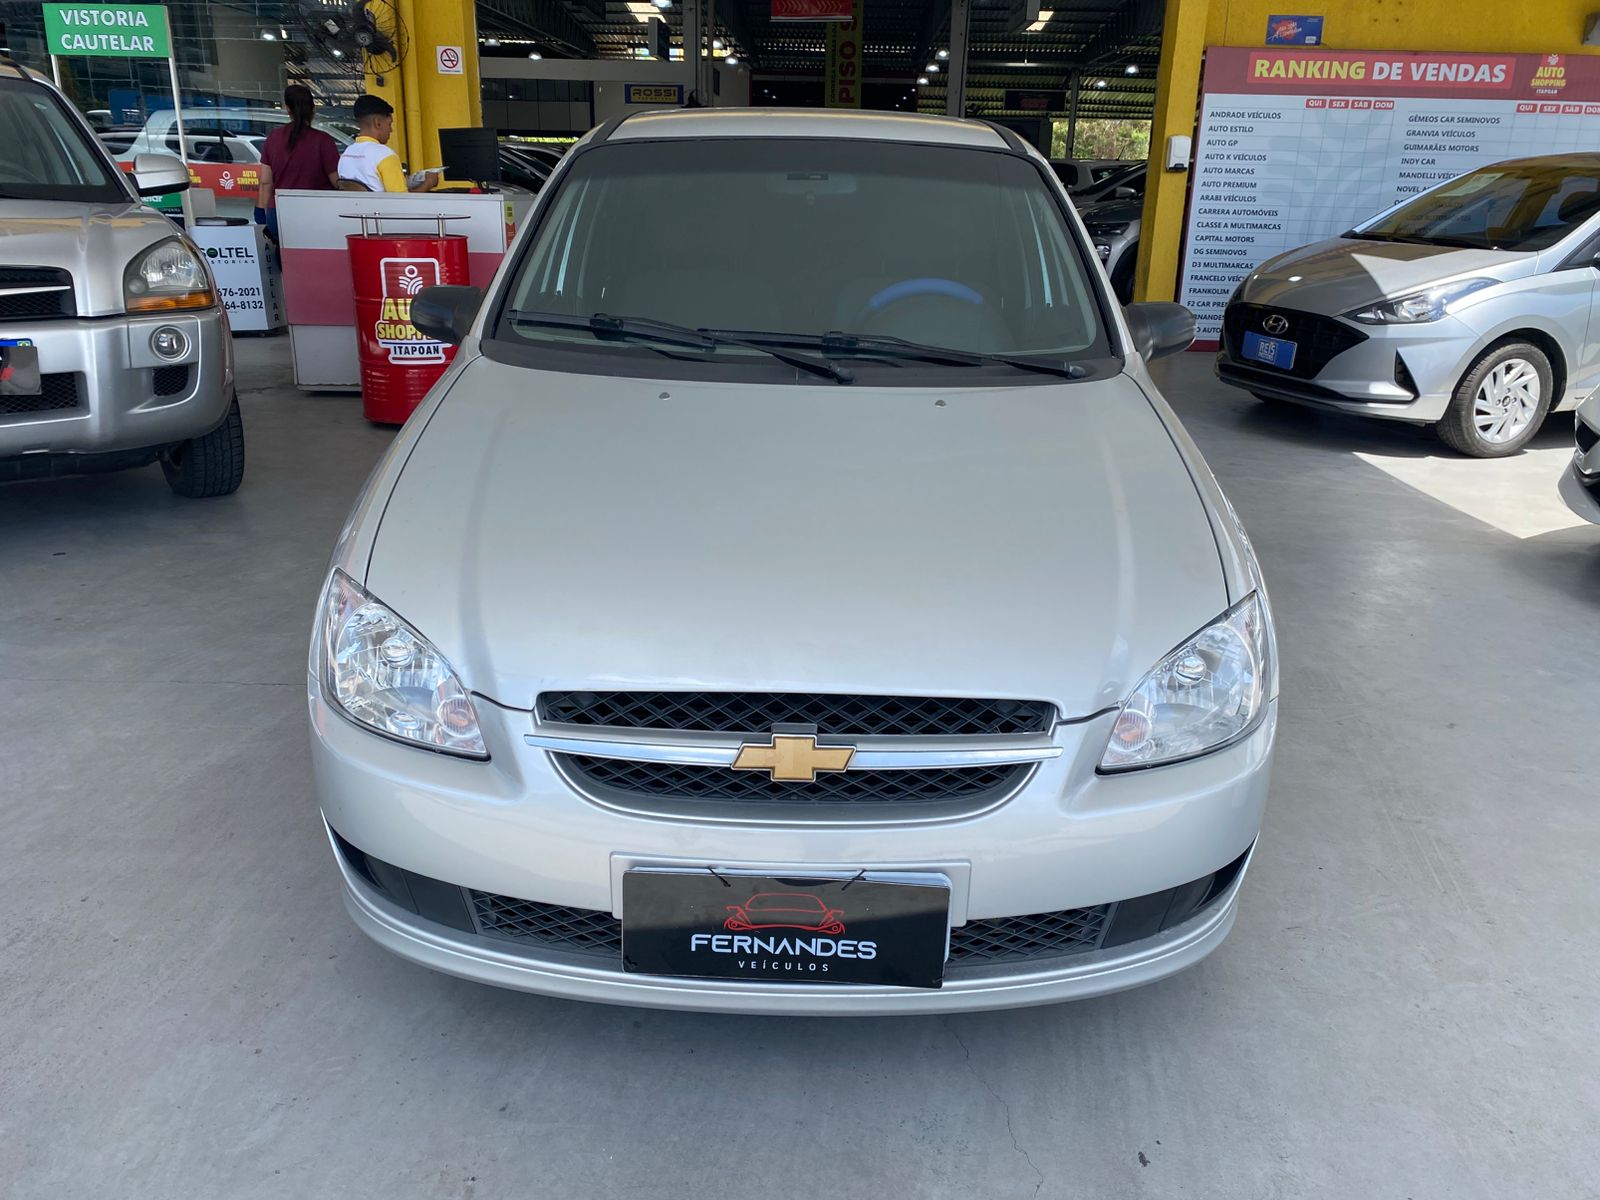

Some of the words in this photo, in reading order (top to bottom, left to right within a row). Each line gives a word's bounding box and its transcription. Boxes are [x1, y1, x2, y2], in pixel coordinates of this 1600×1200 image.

[59, 9, 149, 27] VISTORIA
[61, 33, 155, 52] CAUTELAR
[838, 41, 857, 104] PISO
[1254, 59, 1366, 80] RANKING
[1372, 62, 1404, 80] DE
[1410, 62, 1507, 83] VENDAS
[1536, 66, 1565, 78] AUTO
[1530, 78, 1567, 88] SHOPPING
[632, 88, 676, 97] ROSSI
[1308, 99, 1323, 107] QUI
[1519, 104, 1533, 112] QUI
[1542, 105, 1557, 113] SEX
[1209, 111, 1246, 119] ANDRADE
[1247, 111, 1282, 120] VEÍCULOS
[1440, 115, 1455, 124] CAR
[1456, 116, 1501, 125] SEMINOVOS
[1208, 125, 1229, 133] AUTO
[1406, 129, 1439, 138] GRANVIA
[1441, 129, 1476, 138] VEÍCULOS
[1448, 145, 1480, 153] MOTORS
[1205, 153, 1225, 161] AUTO
[1233, 153, 1267, 162] VEÍCULOS
[1401, 158, 1420, 166] INDY
[1421, 158, 1436, 166] CAR
[242, 170, 257, 178] AUTO
[1203, 167, 1224, 175] AUTO
[1225, 168, 1255, 176] MARCAS
[1399, 172, 1436, 180] MANDELLI
[1223, 181, 1257, 189] PREMIUM
[1396, 186, 1421, 194] NOVEL
[1223, 194, 1257, 203] VEÍCULOS
[1198, 208, 1230, 216] CARRERA
[1233, 208, 1279, 217] AUTOMÓVEIS
[1230, 222, 1281, 231] MULTIMARCAS
[1195, 235, 1223, 243] CAPITAL
[1224, 236, 1255, 244] MOTORS
[1193, 248, 1204, 256] DG
[1205, 248, 1247, 257] SEMINOVOS
[1203, 262, 1254, 271] MULTIMARCAS
[264, 242, 280, 321] AUTELAR
[1190, 274, 1226, 283] FRANCELO
[1188, 287, 1229, 296] FRANKOLIM
[224, 300, 264, 310] 64-8132
[1187, 300, 1196, 308] F2
[1196, 300, 1211, 308] CAR
[383, 298, 412, 320] AU
[1194, 313, 1225, 321] RNANDE
[377, 323, 432, 340] SHOP
[393, 345, 440, 355] ITAPOAN
[690, 933, 878, 960] FERNANDES
[738, 960, 830, 972] VEÍCULOS
